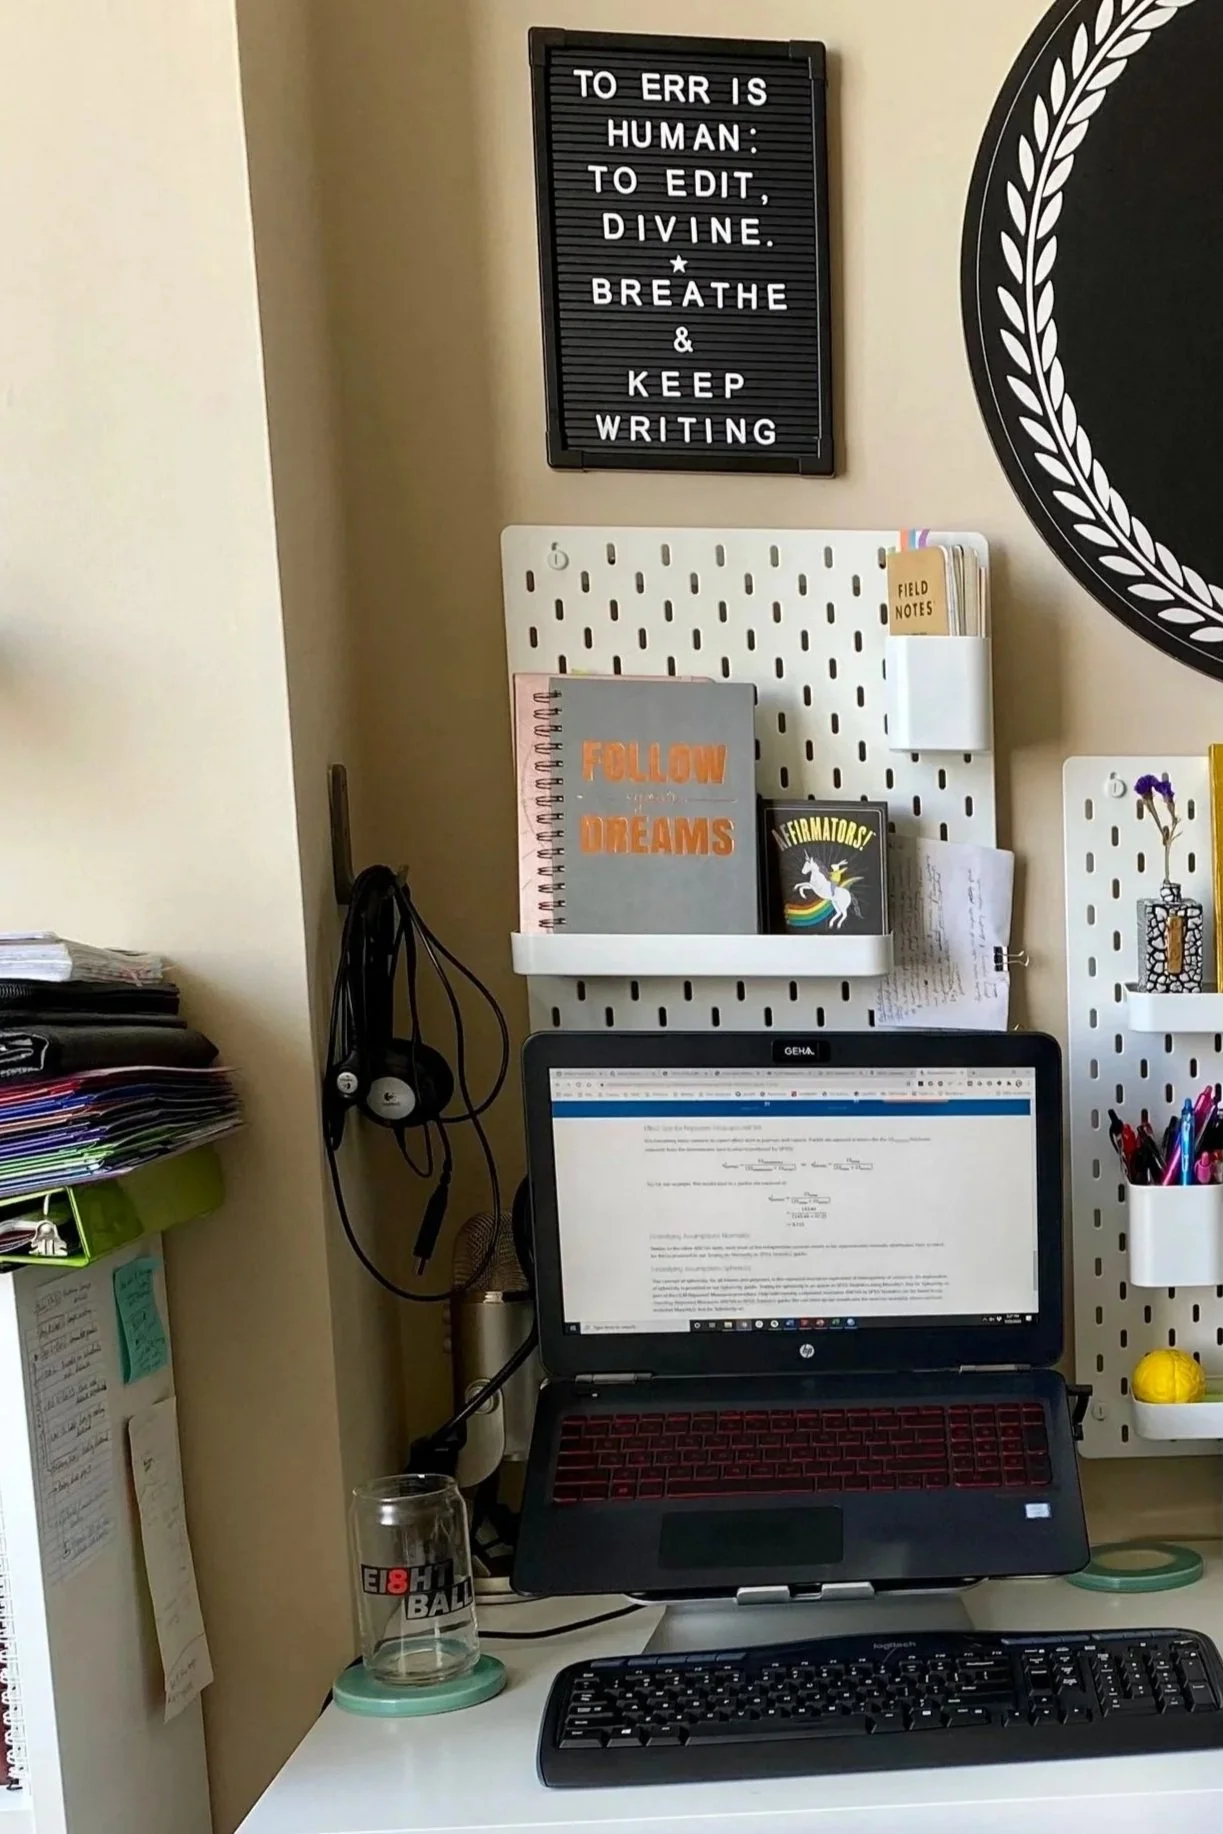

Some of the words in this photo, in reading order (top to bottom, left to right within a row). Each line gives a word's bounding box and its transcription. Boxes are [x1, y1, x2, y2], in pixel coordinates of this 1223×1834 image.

[573, 70, 617, 99] TO
[641, 73, 711, 104] ERR
[732, 77, 767, 106] IS
[607, 119, 757, 154] HUMAN:
[588, 165, 638, 195] TO
[666, 169, 768, 206] EDIT,
[603, 213, 773, 247] DIVINE.
[592, 278, 788, 311] BREATHE
[673, 327, 694, 353] &
[628, 370, 745, 399] KEEP
[596, 414, 776, 446] WRITING
[898, 580, 929, 598] FIELD
[896, 600, 933, 620] NOTES
[581, 740, 727, 785] FOLLOW
[580, 815, 735, 856] DREAMS
[771, 816, 874, 851] AFFIRMATORS!
[407, 1581, 472, 1619] BALL
